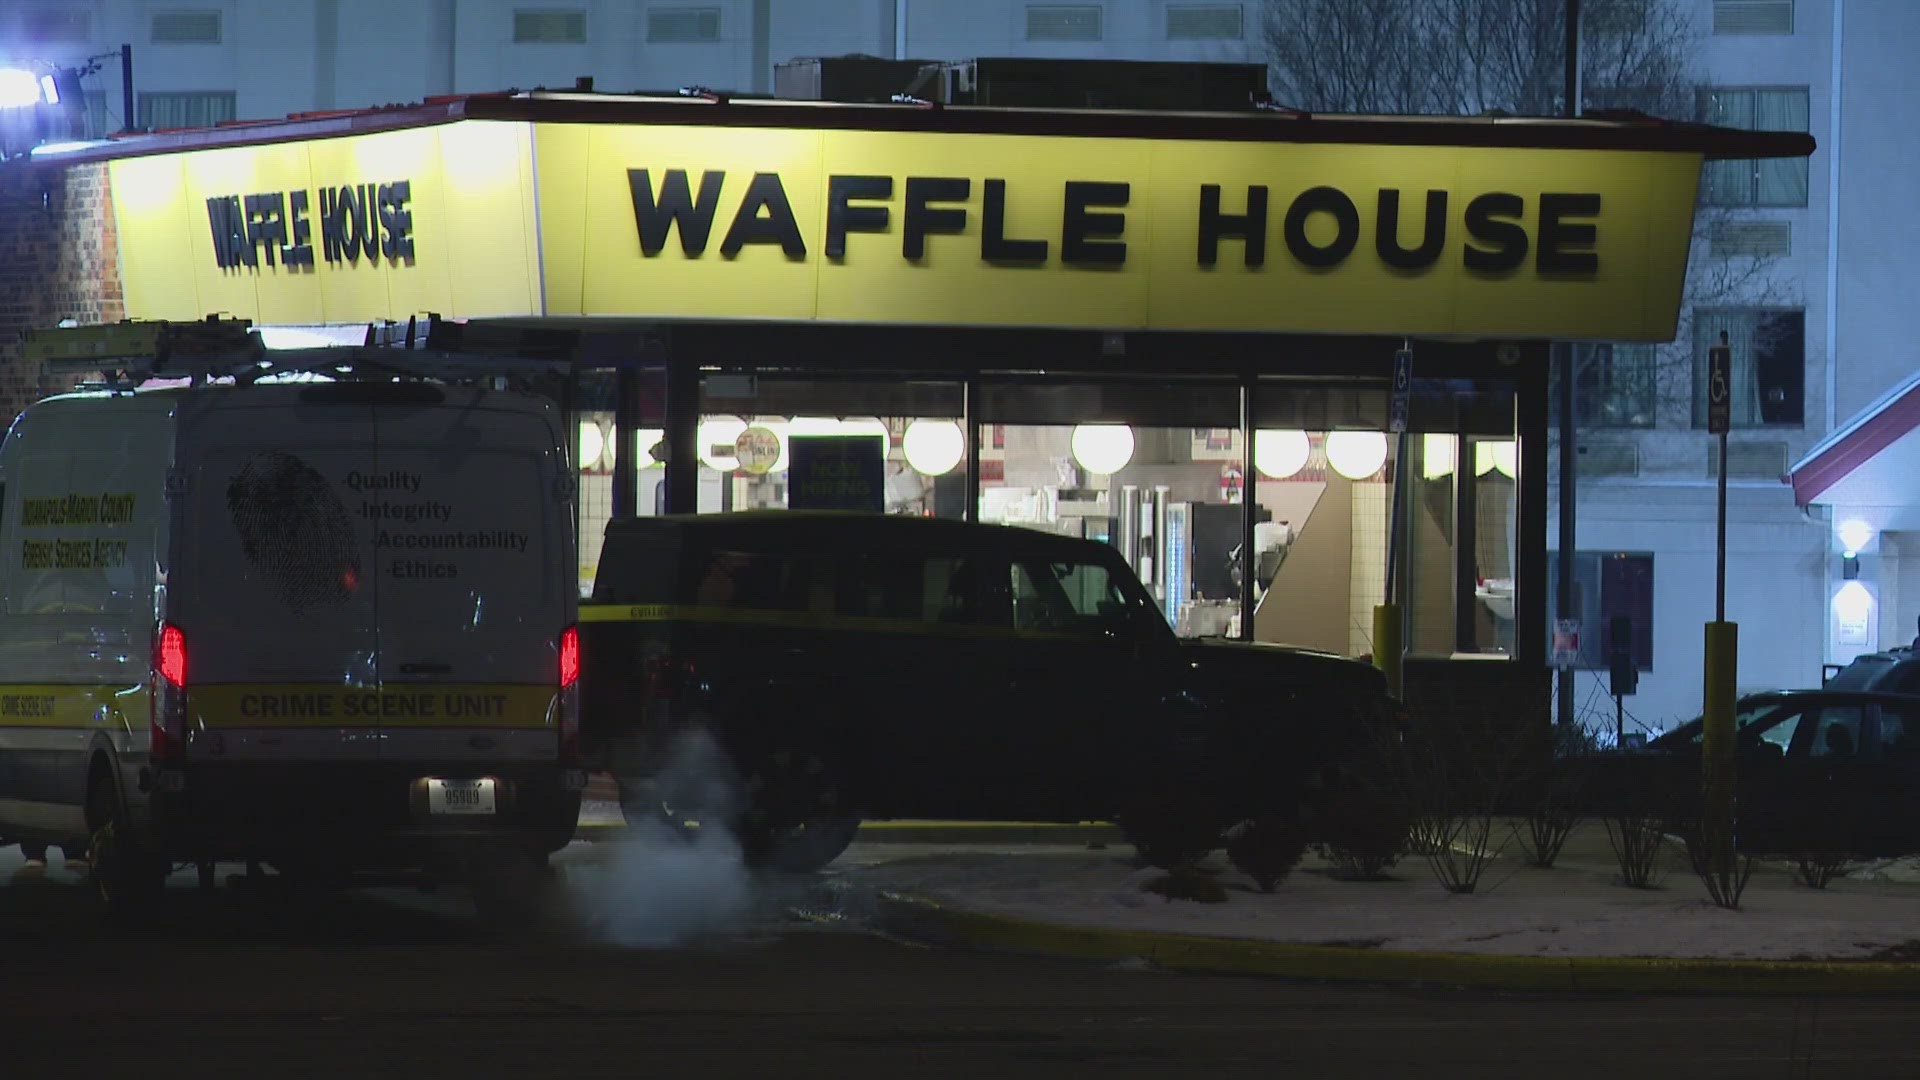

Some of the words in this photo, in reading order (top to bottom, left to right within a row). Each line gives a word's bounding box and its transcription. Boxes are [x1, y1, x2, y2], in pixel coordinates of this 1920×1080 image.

[206, 189, 315, 268] WAFFLE
[319, 180, 415, 266] HOUSE
[627, 168, 1130, 263] WAFFLE
[1197, 184, 1602, 276] HOUSE
[240, 693, 334, 718] CRIME
[343, 693, 435, 718] SCENE
[445, 693, 507, 717] UNIT
